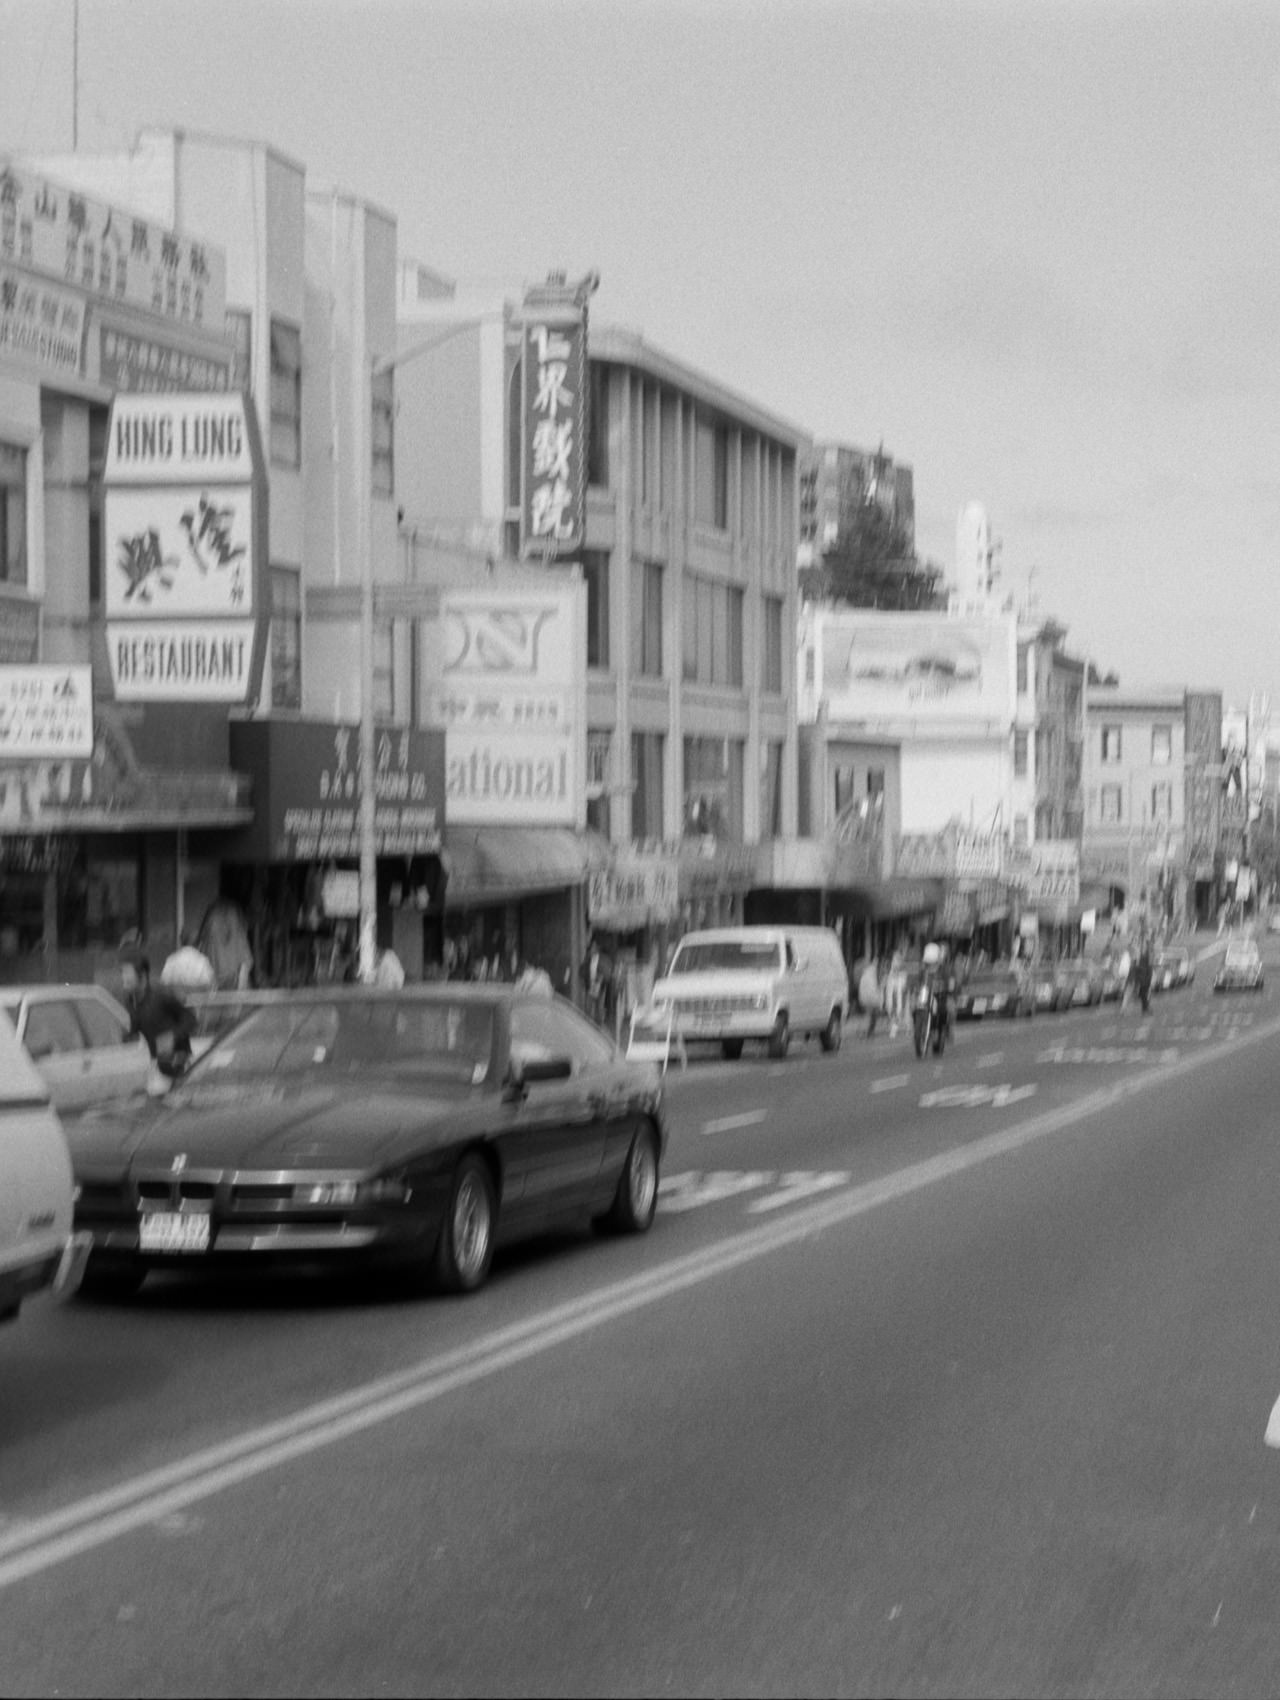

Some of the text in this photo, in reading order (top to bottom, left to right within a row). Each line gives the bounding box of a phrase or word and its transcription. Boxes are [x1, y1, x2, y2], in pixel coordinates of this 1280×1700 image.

[117, 414, 243, 462] HING LUNG
[118, 635, 245, 681] RESTAURANT
[447, 746, 568, 799] ational
